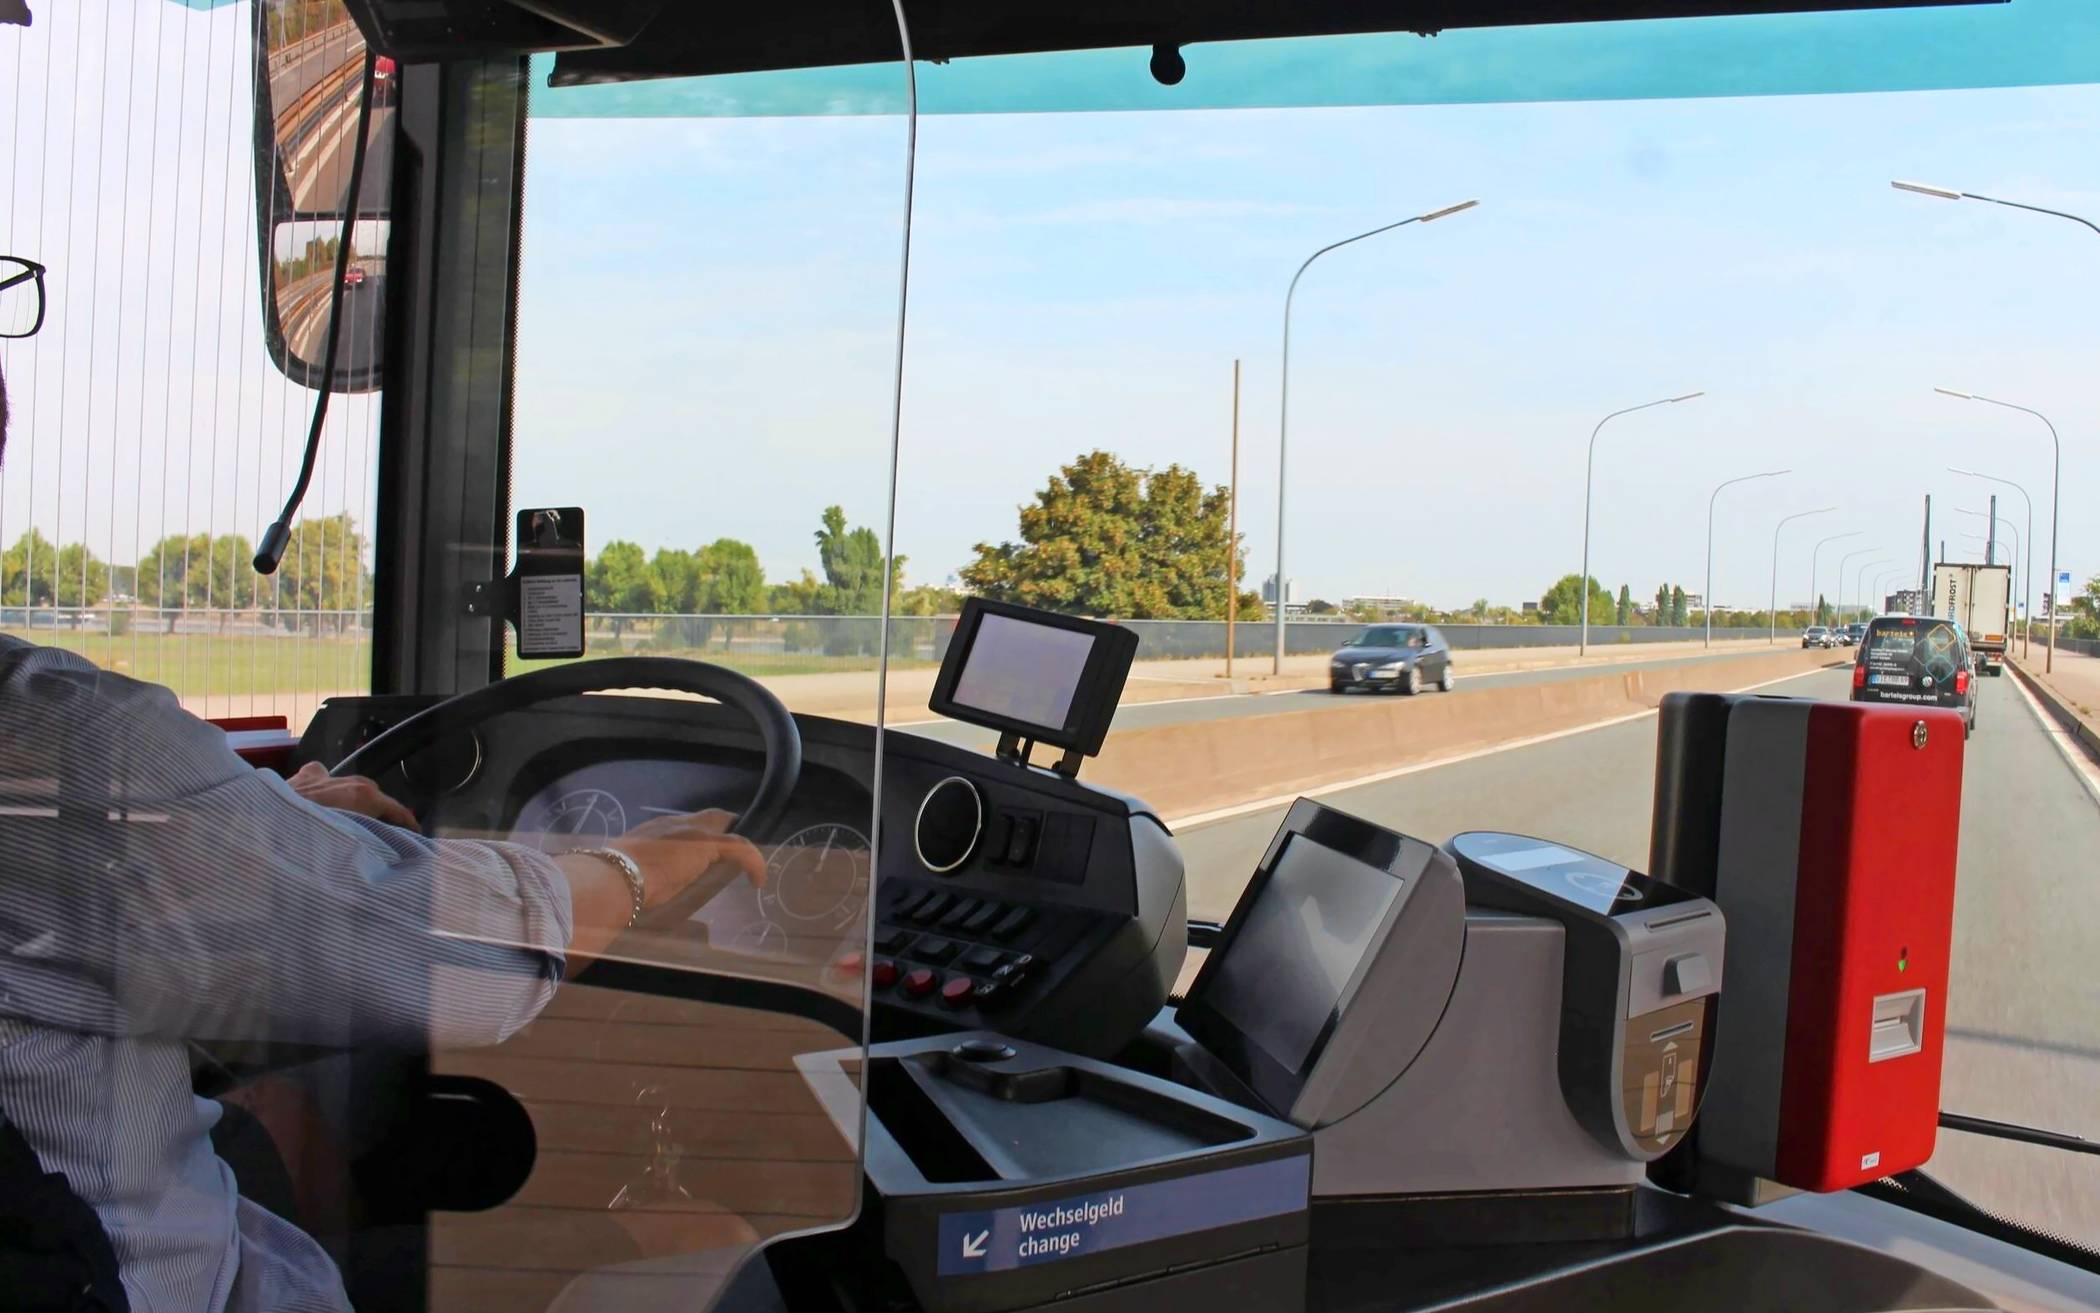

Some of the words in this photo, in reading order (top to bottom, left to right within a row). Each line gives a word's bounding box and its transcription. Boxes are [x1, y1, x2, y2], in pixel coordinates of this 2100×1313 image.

[1880, 691, 1938, 701] bartelsgroup.com
[1020, 1195, 1124, 1233] Wechselgeld
[1019, 1232, 1080, 1257] change
